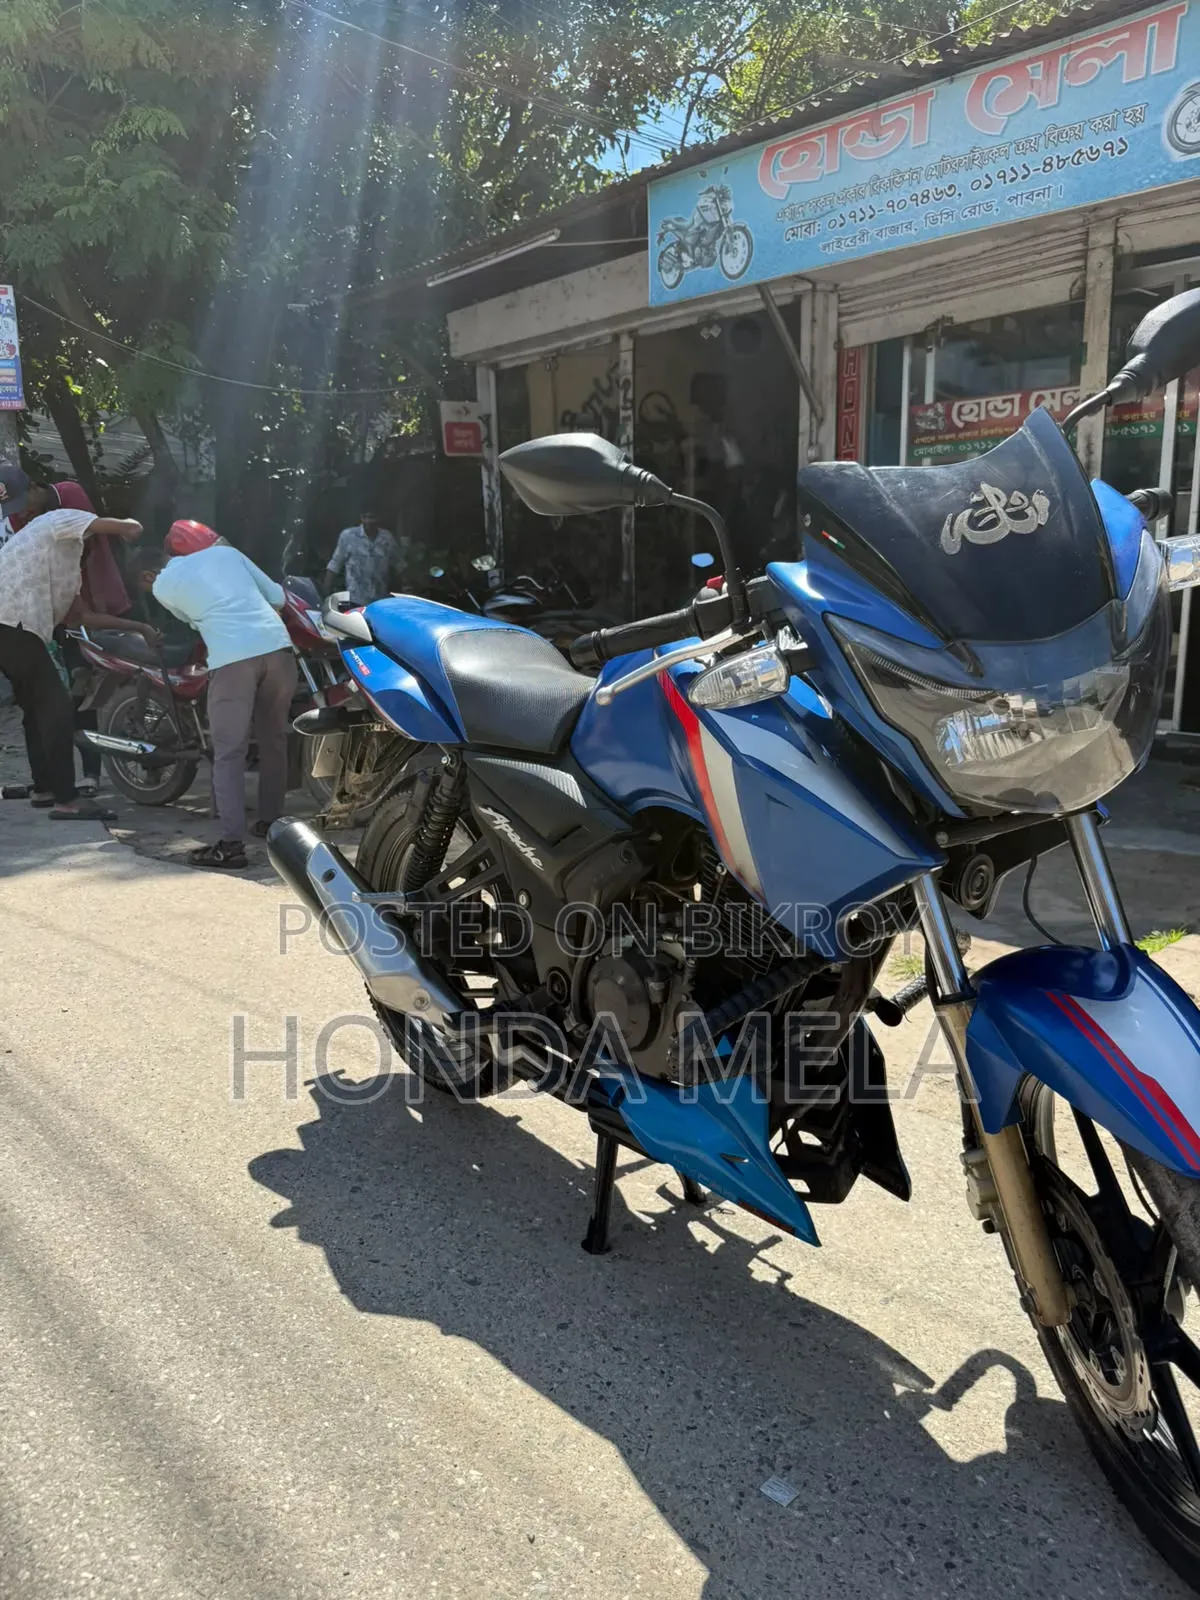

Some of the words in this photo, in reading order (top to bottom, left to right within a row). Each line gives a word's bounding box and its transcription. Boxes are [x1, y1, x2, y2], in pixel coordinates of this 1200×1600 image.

[758, 88, 936, 199] হোন্ডা
[965, 1, 1188, 135] মেলা
[776, 202, 805, 222] এখানে
[836, 183, 868, 206] প্রকার
[924, 142, 1012, 184] মোটরসাইকেল
[1014, 132, 1042, 156] ক্রয়
[1043, 119, 1087, 149] বিক্রয়
[1089, 108, 1121, 134] করা
[1121, 102, 1149, 127] হয়
[827, 182, 962, 231] ০১৭১১-৭০৭৪৬৩,
[970, 136, 1129, 192] ০১৭১১-৪৮৫৬৭১
[820, 228, 870, 254] লাইব্রেরী
[875, 219, 918, 239] বাজার,
[924, 207, 956, 228] ডিসি
[961, 199, 999, 220] রোড,
[952, 393, 1021, 428] হোন্ডা
[1029, 386, 1080, 412] মেল
[478, 805, 544, 872] Apache
